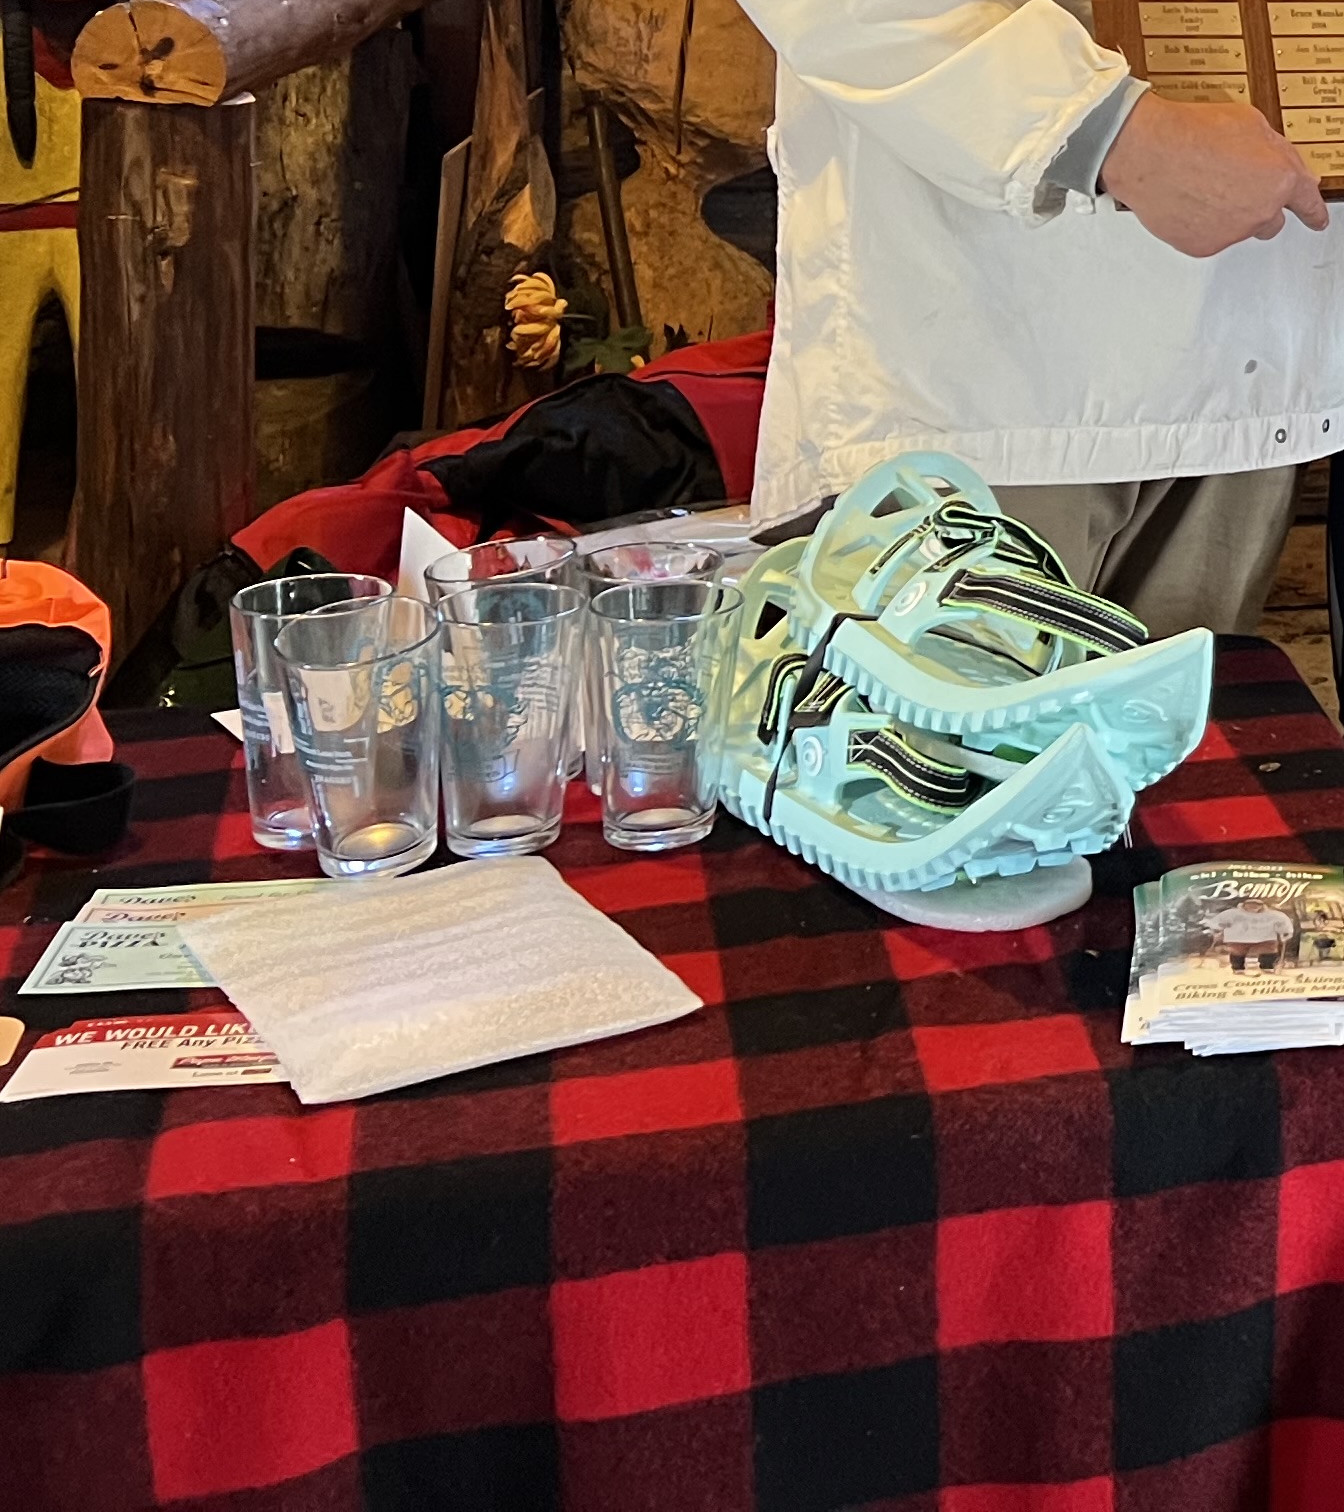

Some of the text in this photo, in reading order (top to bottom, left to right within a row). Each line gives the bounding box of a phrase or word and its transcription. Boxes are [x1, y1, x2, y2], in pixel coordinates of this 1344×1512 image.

[1223, 978, 1288, 990] Country
[54, 1030, 97, 1046] WE
[105, 1024, 197, 1042] WOULD
[120, 1039, 171, 1050] FREE
[177, 1038, 217, 1048] Any
